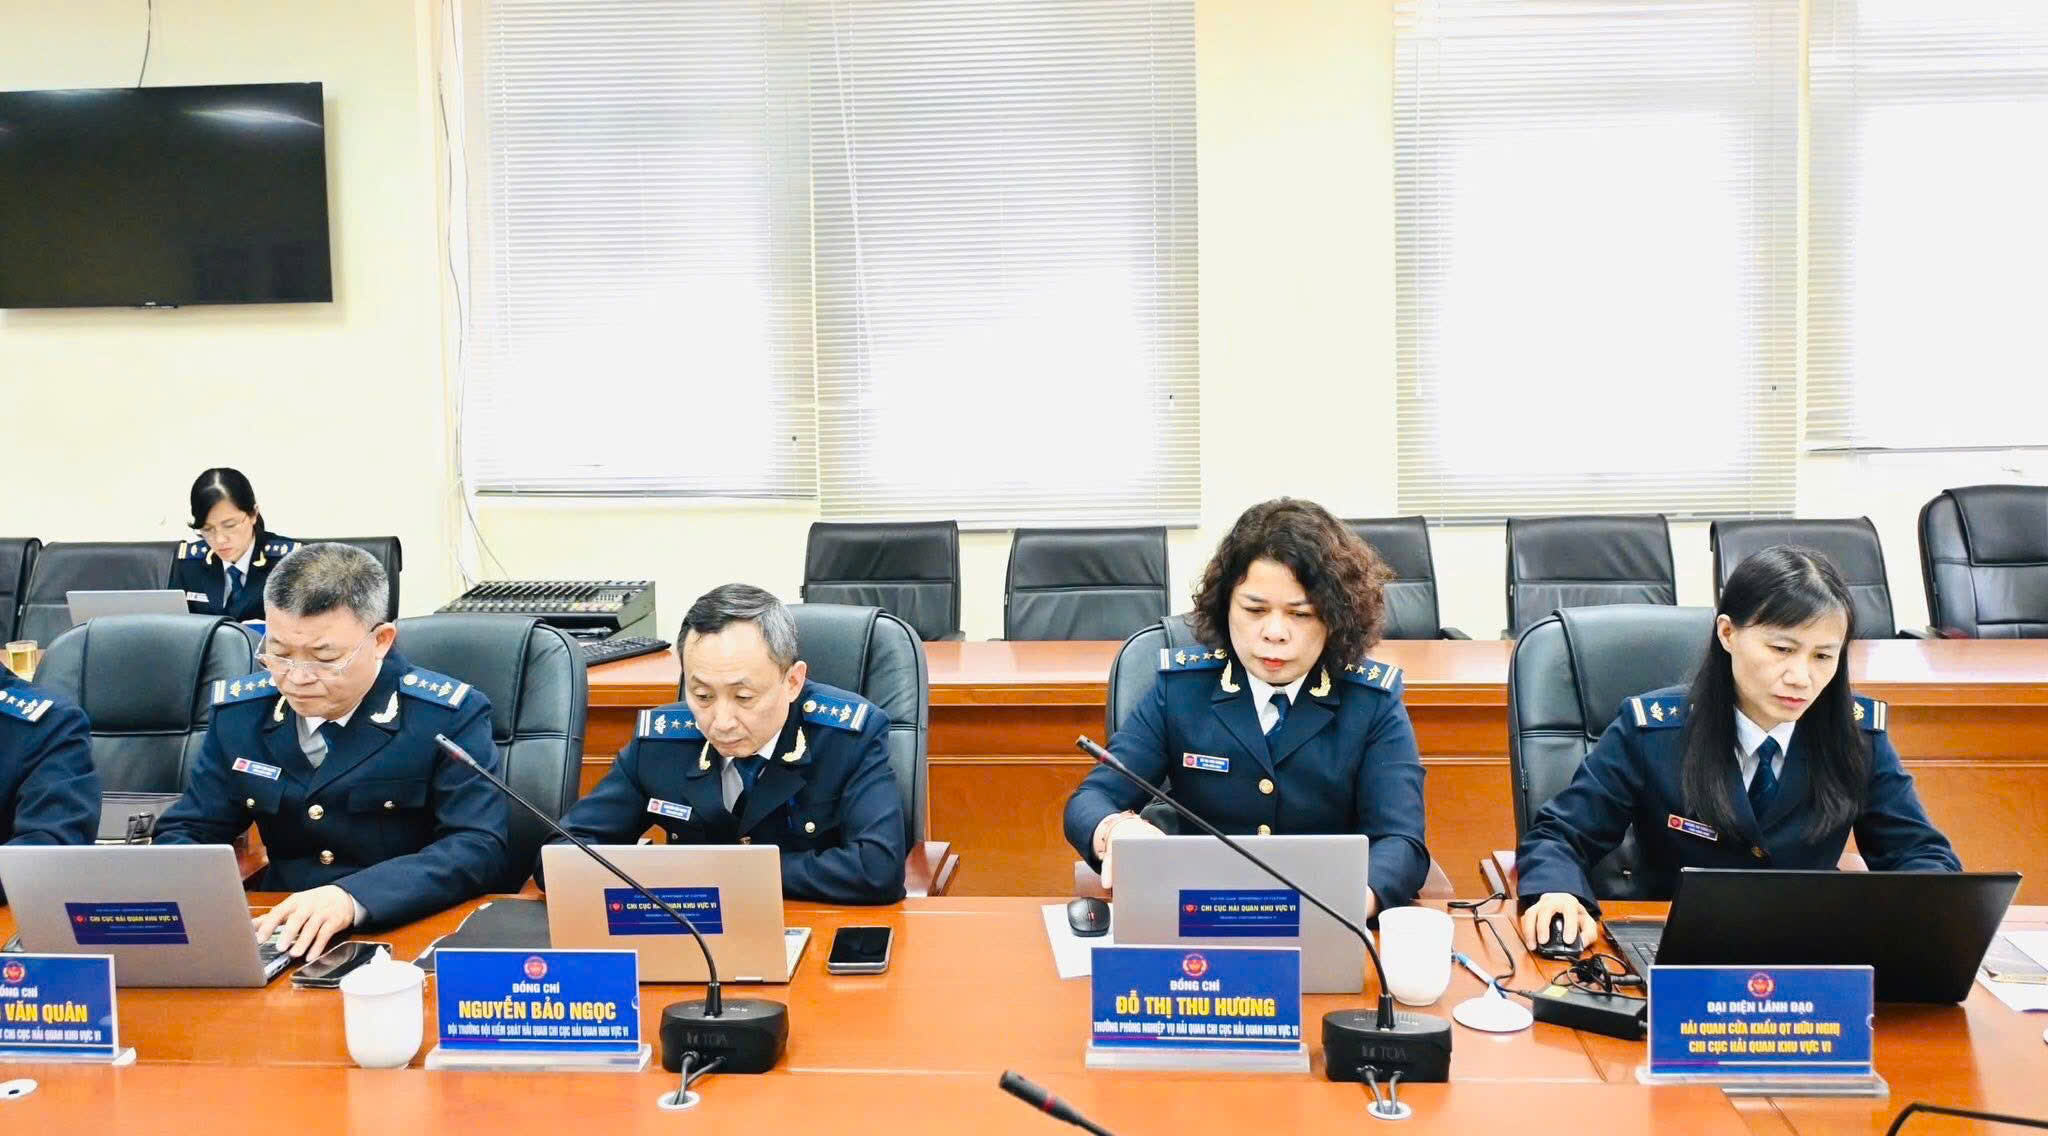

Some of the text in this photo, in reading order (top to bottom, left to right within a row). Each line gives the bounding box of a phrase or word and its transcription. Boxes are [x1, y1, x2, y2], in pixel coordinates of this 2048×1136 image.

[21, 986, 38, 998] CHÍ
[543, 981, 560, 993] CHÍ
[1202, 979, 1220, 992] CHÍ
[458, 995, 616, 1023] NGUYỄN BẢO NGỌC
[1116, 990, 1276, 1019] ĐỖ THỊ THU HƯƠNG
[1707, 1000, 1813, 1014] ĐẠI DIỆN LÃNH ĐẠO
[5, 1000, 88, 1024] VĂN QUÂN
[1292, 1025, 1298, 1036] VI
[1680, 1020, 1697, 1034] HẢI
[1700, 1023, 1726, 1035] QUAN
[1779, 1023, 1792, 1035] QT
[1689, 1037, 1832, 1054] CHI CỤC HẢI QUAN KHU VỰC VI
